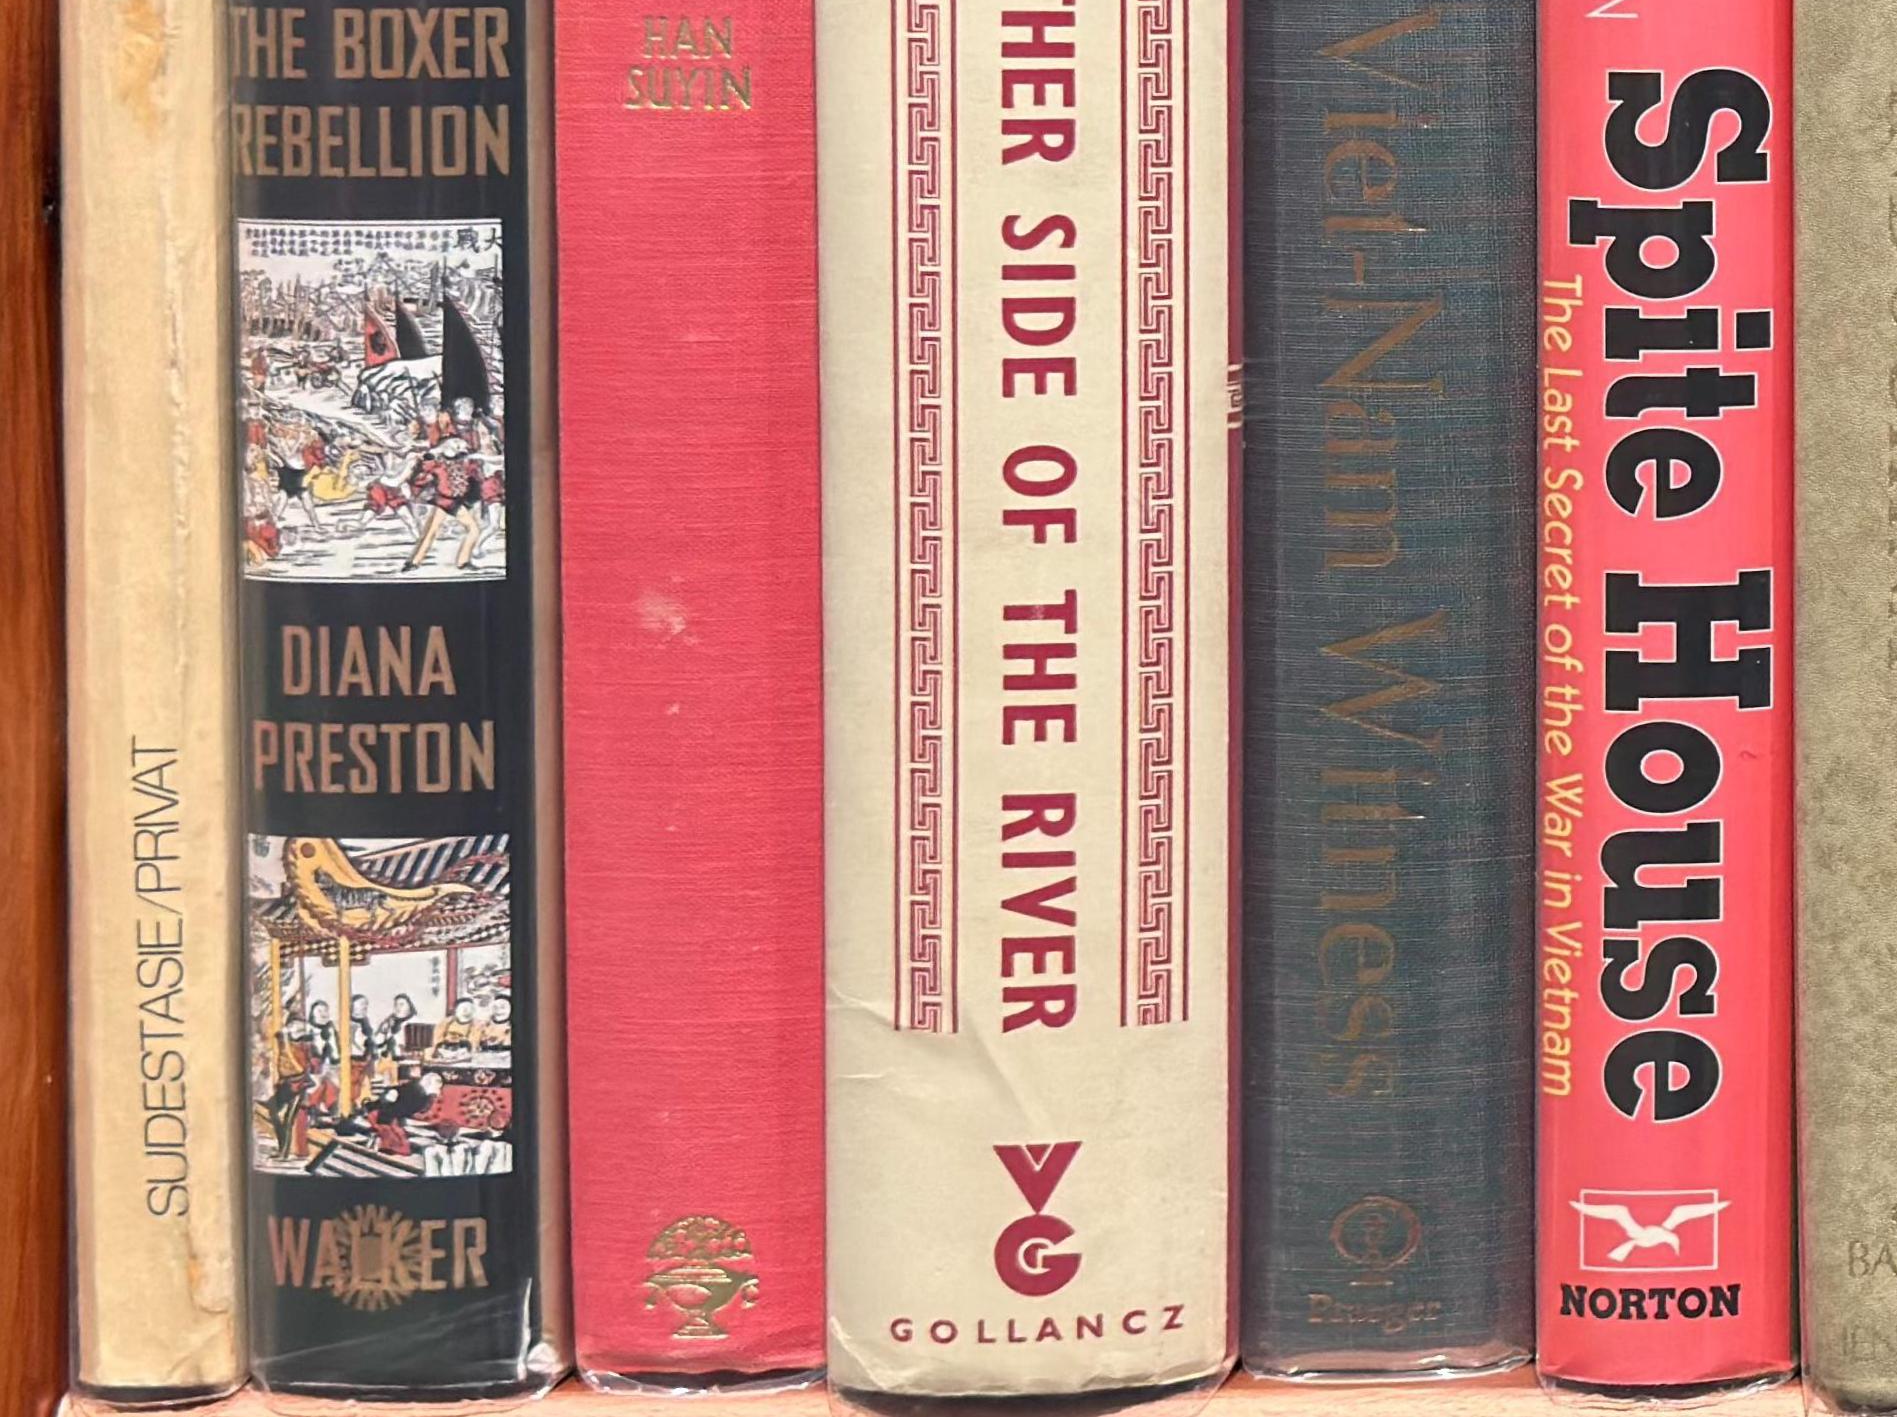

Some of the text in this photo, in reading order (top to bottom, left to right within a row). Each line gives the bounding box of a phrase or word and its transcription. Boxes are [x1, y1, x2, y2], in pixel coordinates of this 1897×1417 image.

[230, 6, 511, 80] THE BOXER
[643, 14, 733, 61] HAN
[625, 66, 752, 113] SUYIN
[233, 103, 511, 179] REBELLION
[1000, 214, 1078, 398] SIDE
[1318, 12, 1447, 574] Viet-Nam
[1002, 445, 1078, 544] OF
[1568, 65, 1775, 1124] Spite House
[281, 625, 457, 697] DIANA
[1002, 600, 1078, 746] THE
[1541, 274, 1585, 1097] The Last Secret of the War in Vietnam
[253, 721, 496, 794] PRESTON
[1316, 606, 1448, 1100] Witness
[1000, 795, 1078, 1034] RIVER
[267, 1214, 489, 1291] WALKER
[890, 1305, 1186, 1345] GOLLANCZ
[1559, 1282, 1741, 1321] NORTON
